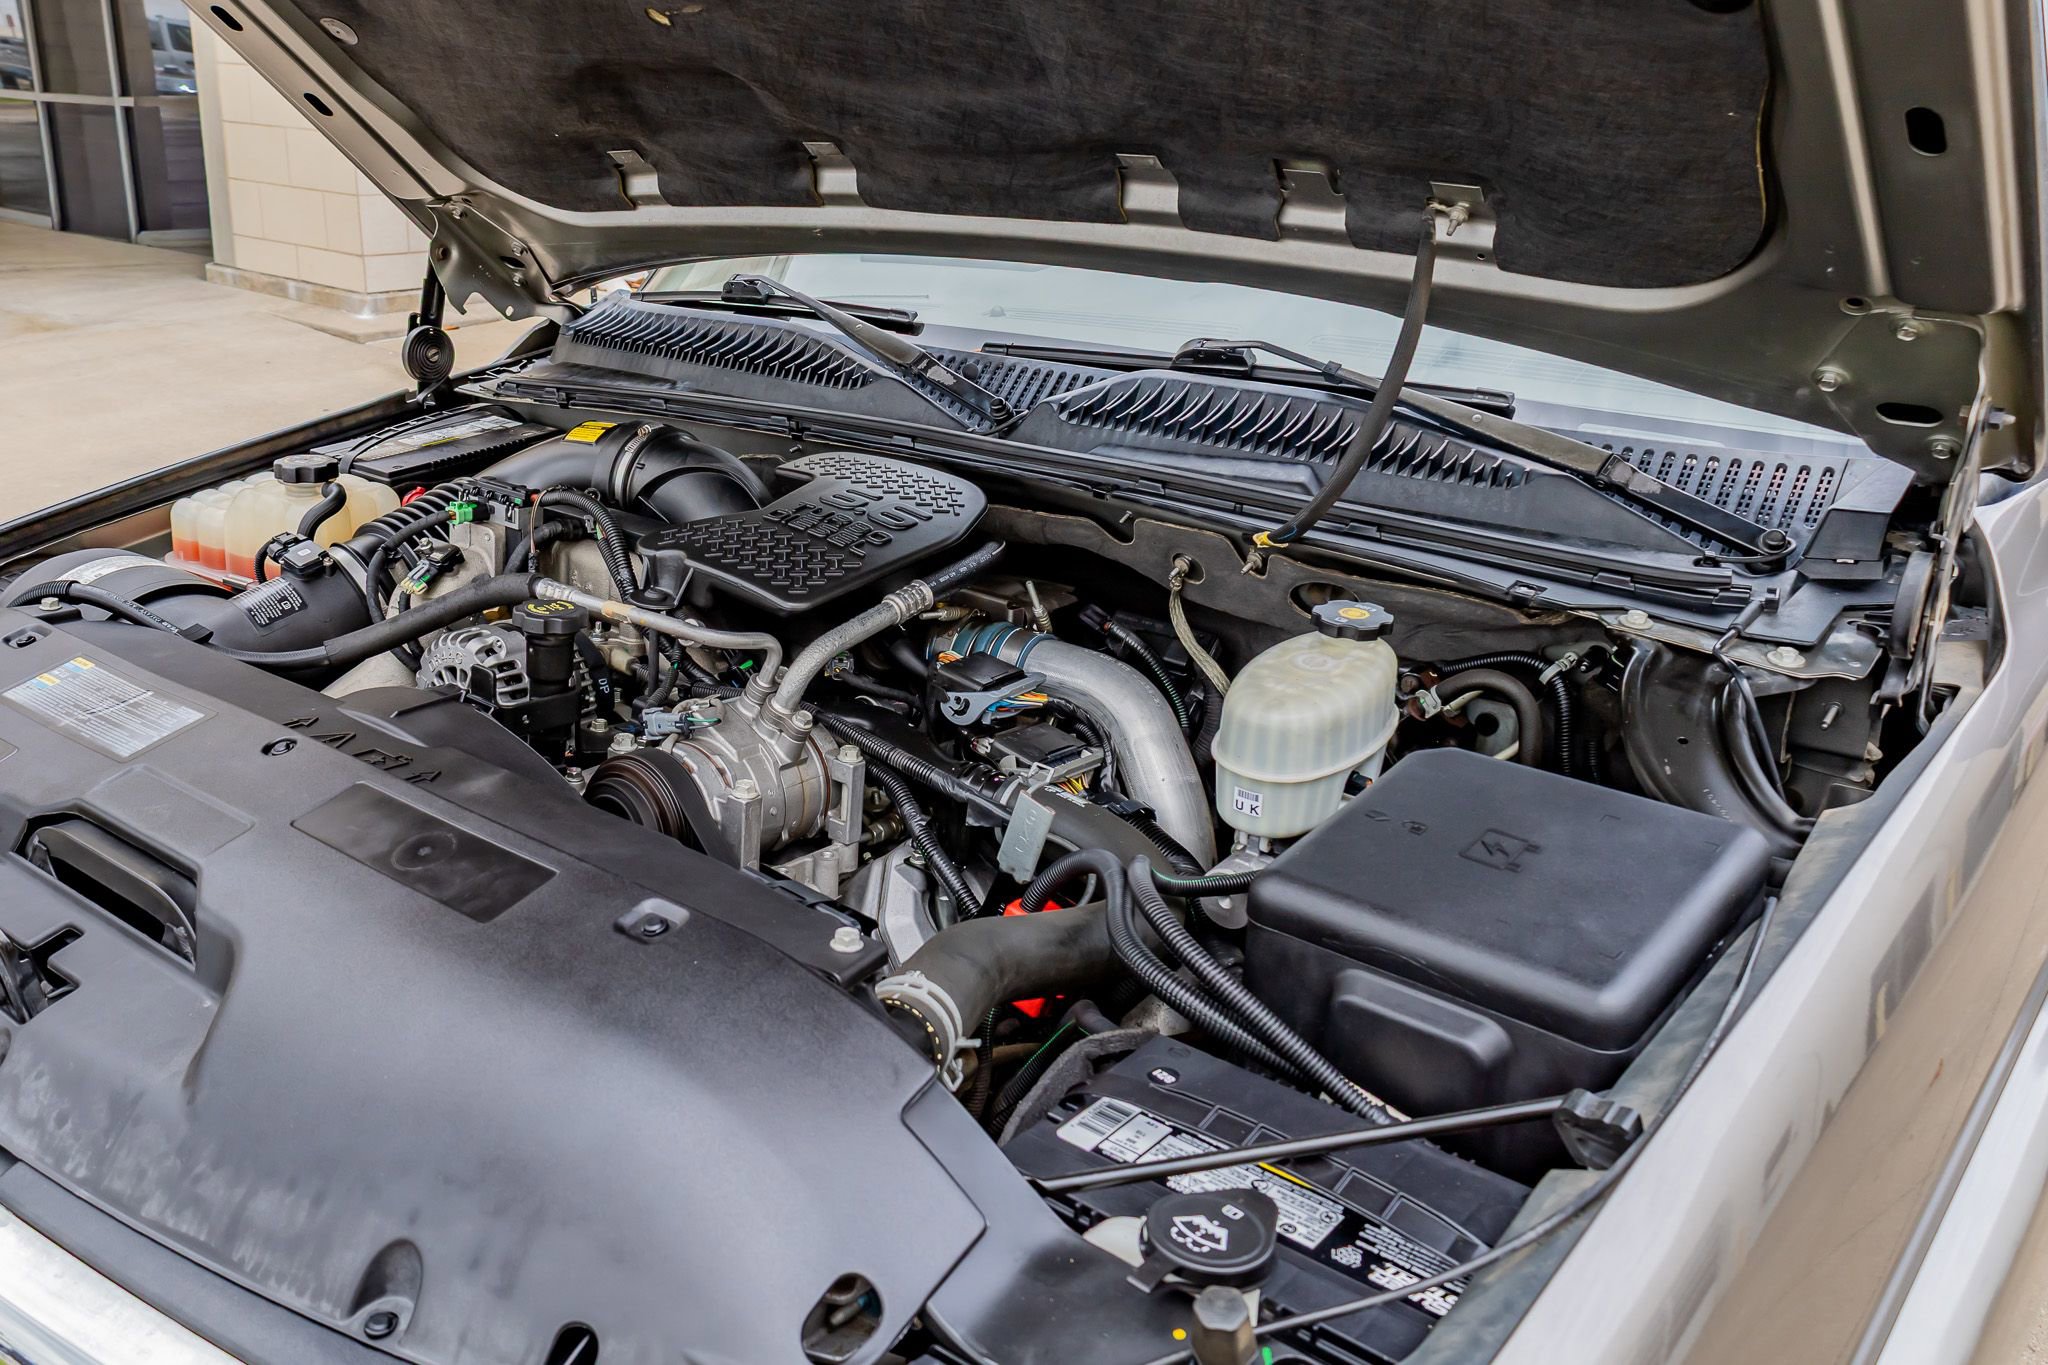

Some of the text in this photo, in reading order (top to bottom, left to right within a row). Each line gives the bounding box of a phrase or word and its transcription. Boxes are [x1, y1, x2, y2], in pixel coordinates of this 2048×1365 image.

[799, 501, 893, 545] TURBO
[819, 485, 934, 530] 6.6
[763, 508, 866, 557] DIESEL
[1368, 1264, 1453, 1316] SUER
